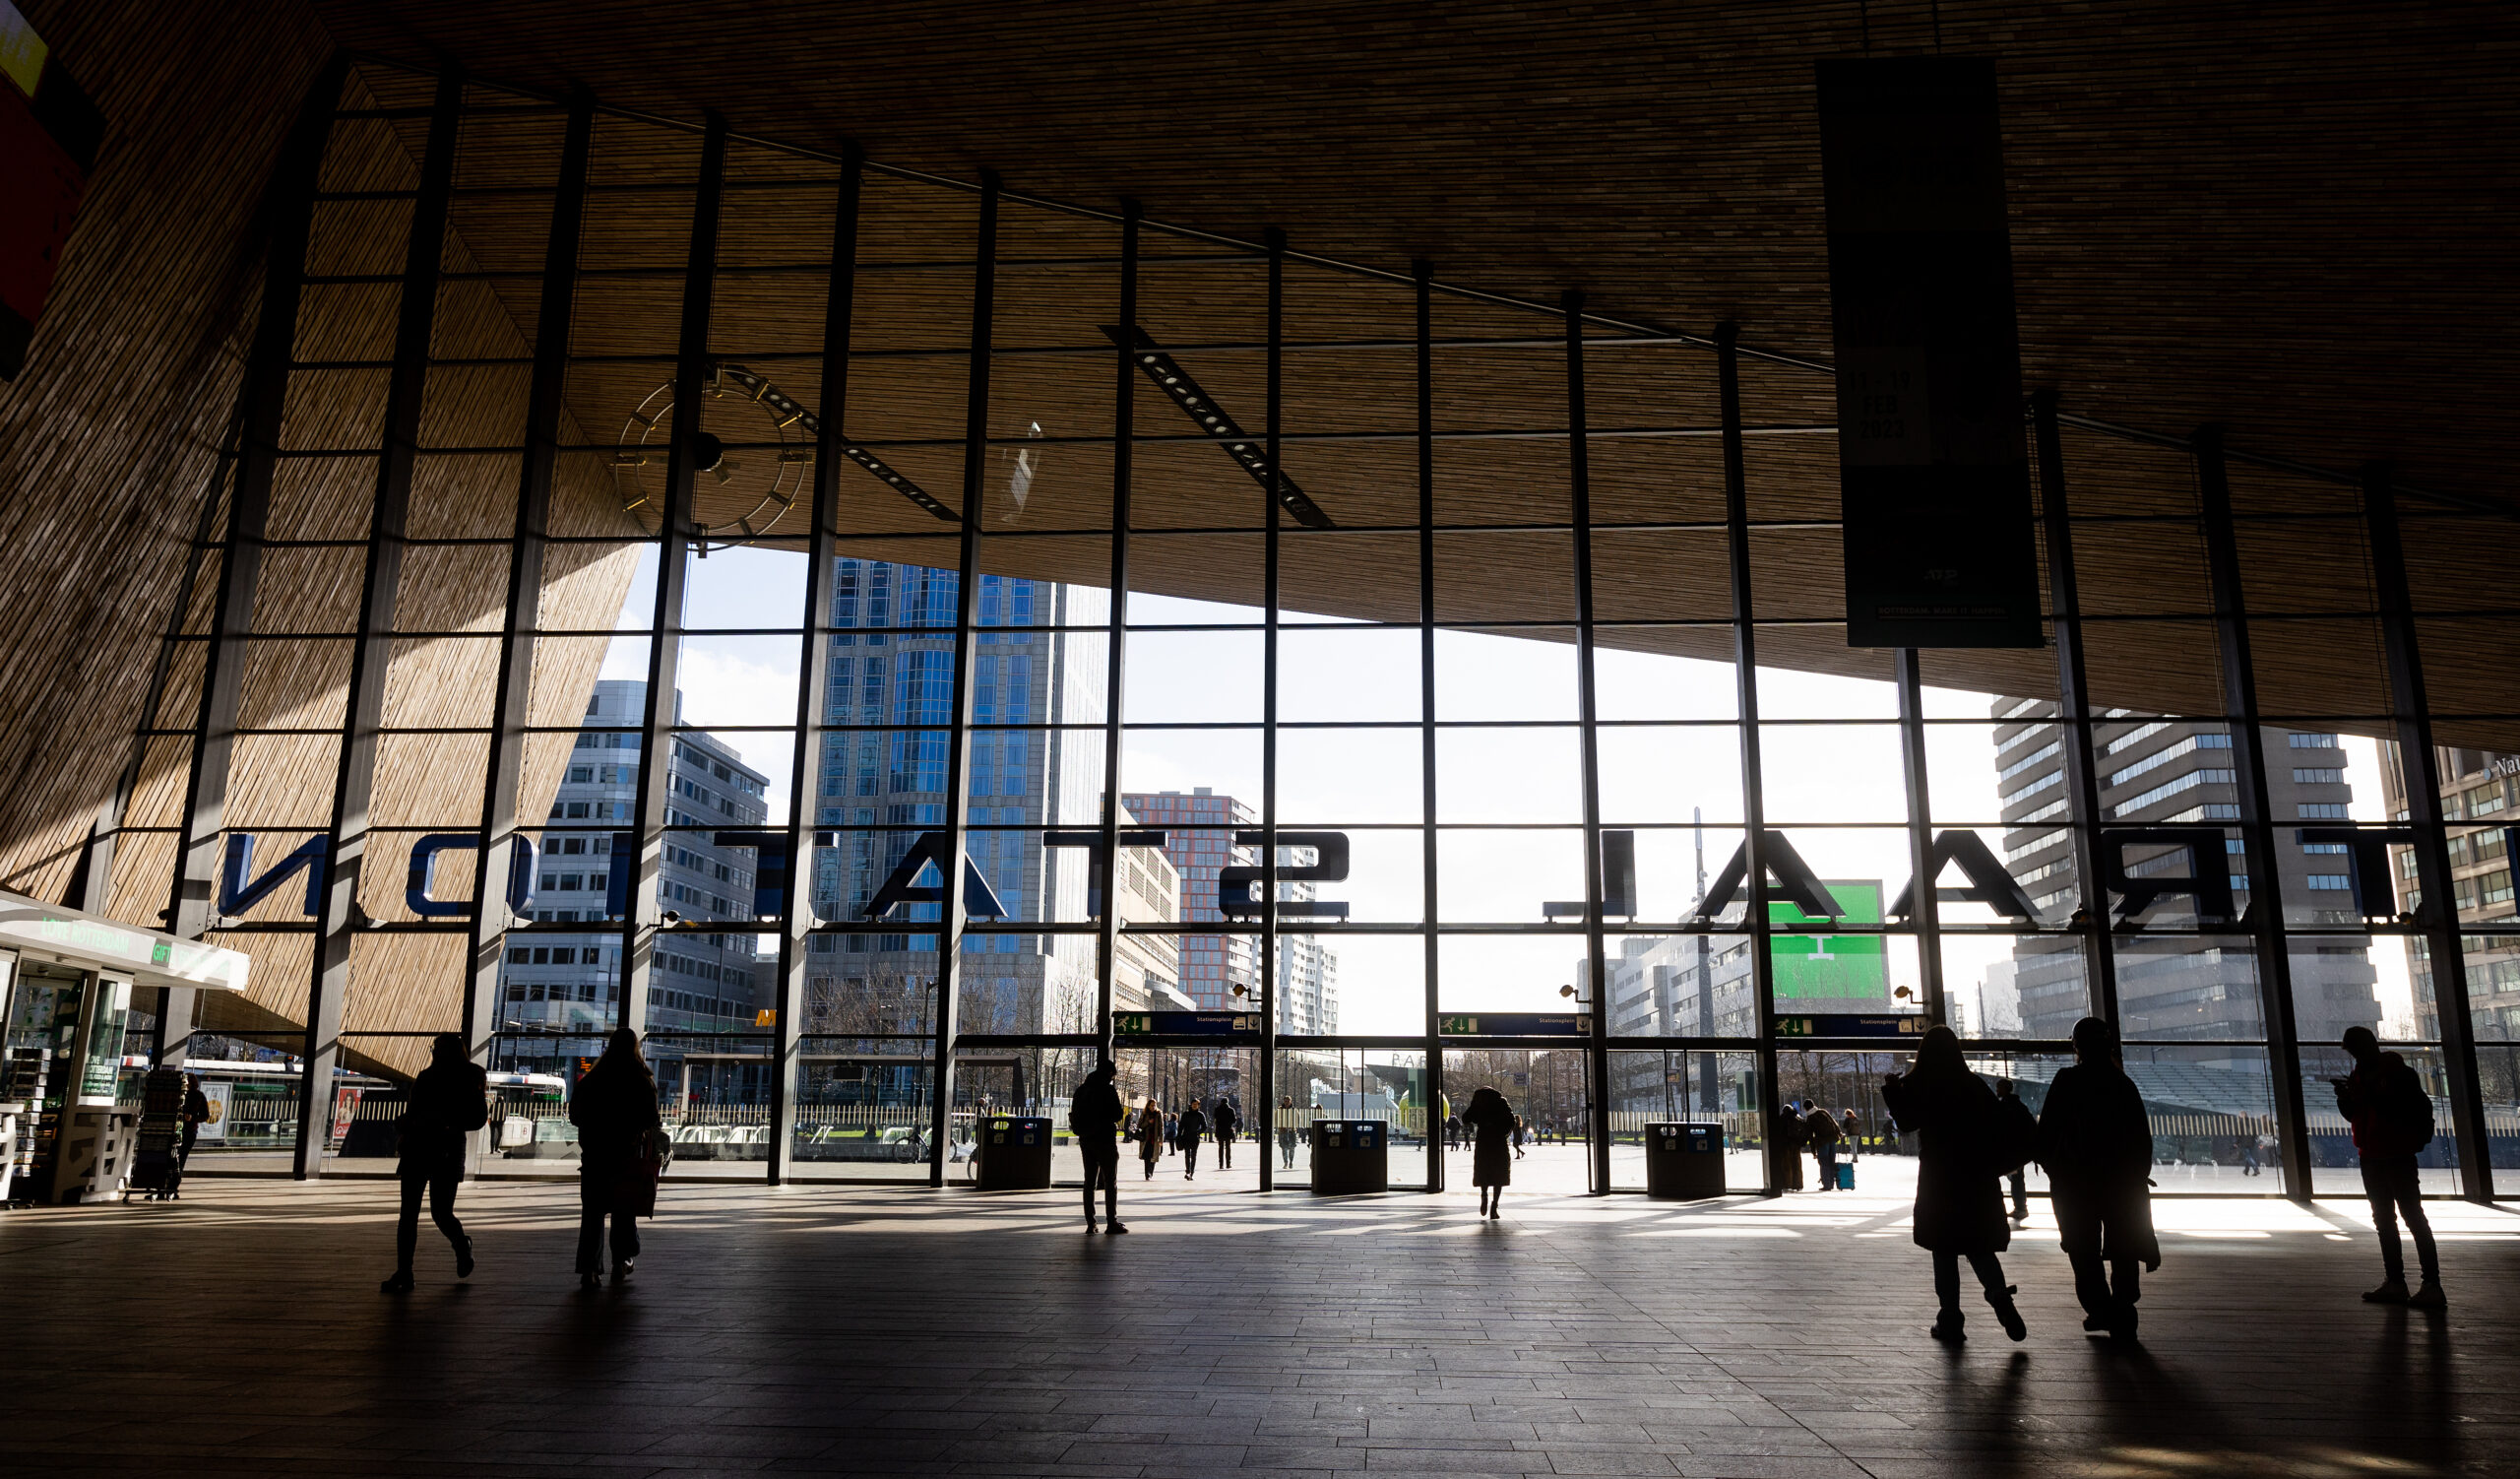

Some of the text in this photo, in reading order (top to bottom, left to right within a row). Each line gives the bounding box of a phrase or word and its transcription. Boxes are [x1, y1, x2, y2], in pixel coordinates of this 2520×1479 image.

[1848, 370, 1867, 392] 11
[1889, 369, 1911, 390] 19
[1862, 395, 1898, 415] FEB
[1858, 418, 1905, 440] 2023
[41, 916, 130, 954] LOVE ROTTERDAM
